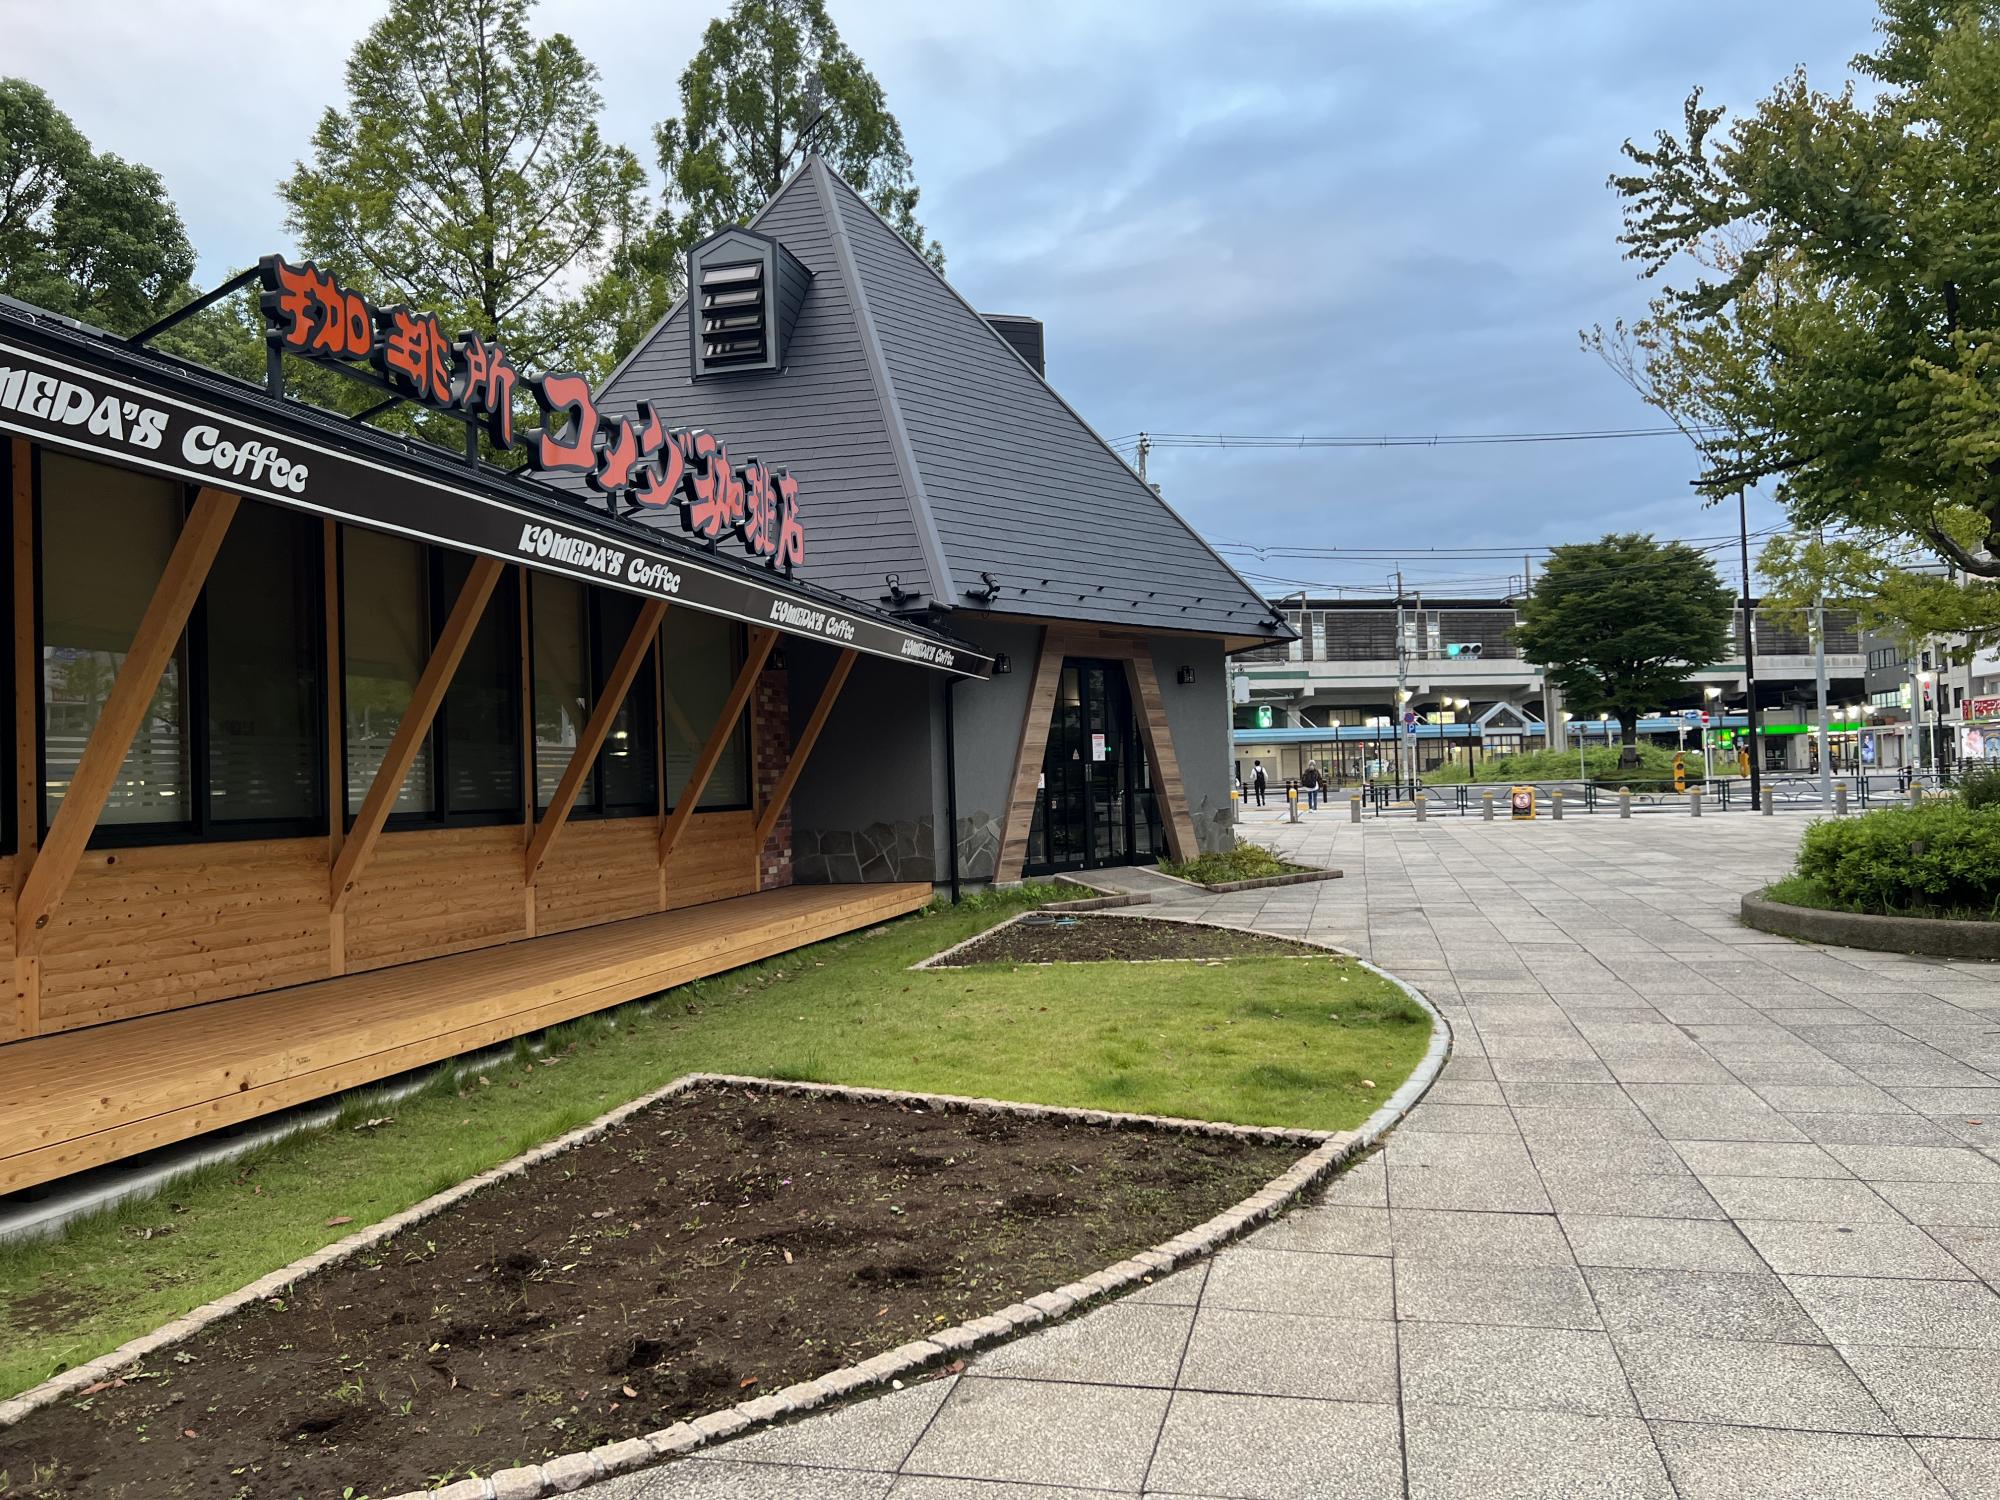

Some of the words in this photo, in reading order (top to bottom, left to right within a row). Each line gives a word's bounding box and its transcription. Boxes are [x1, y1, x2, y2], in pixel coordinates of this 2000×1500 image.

[180, 425, 309, 493] Coffee
[518, 523, 626, 577] KOMEDA'S
[627, 558, 681, 594] Coffee
[769, 599, 826, 631] KOMEDA'S
[826, 616, 855, 641] Coffee
[901, 638, 936, 661] KOMEDA'S
[935, 648, 955, 666] Coffee
